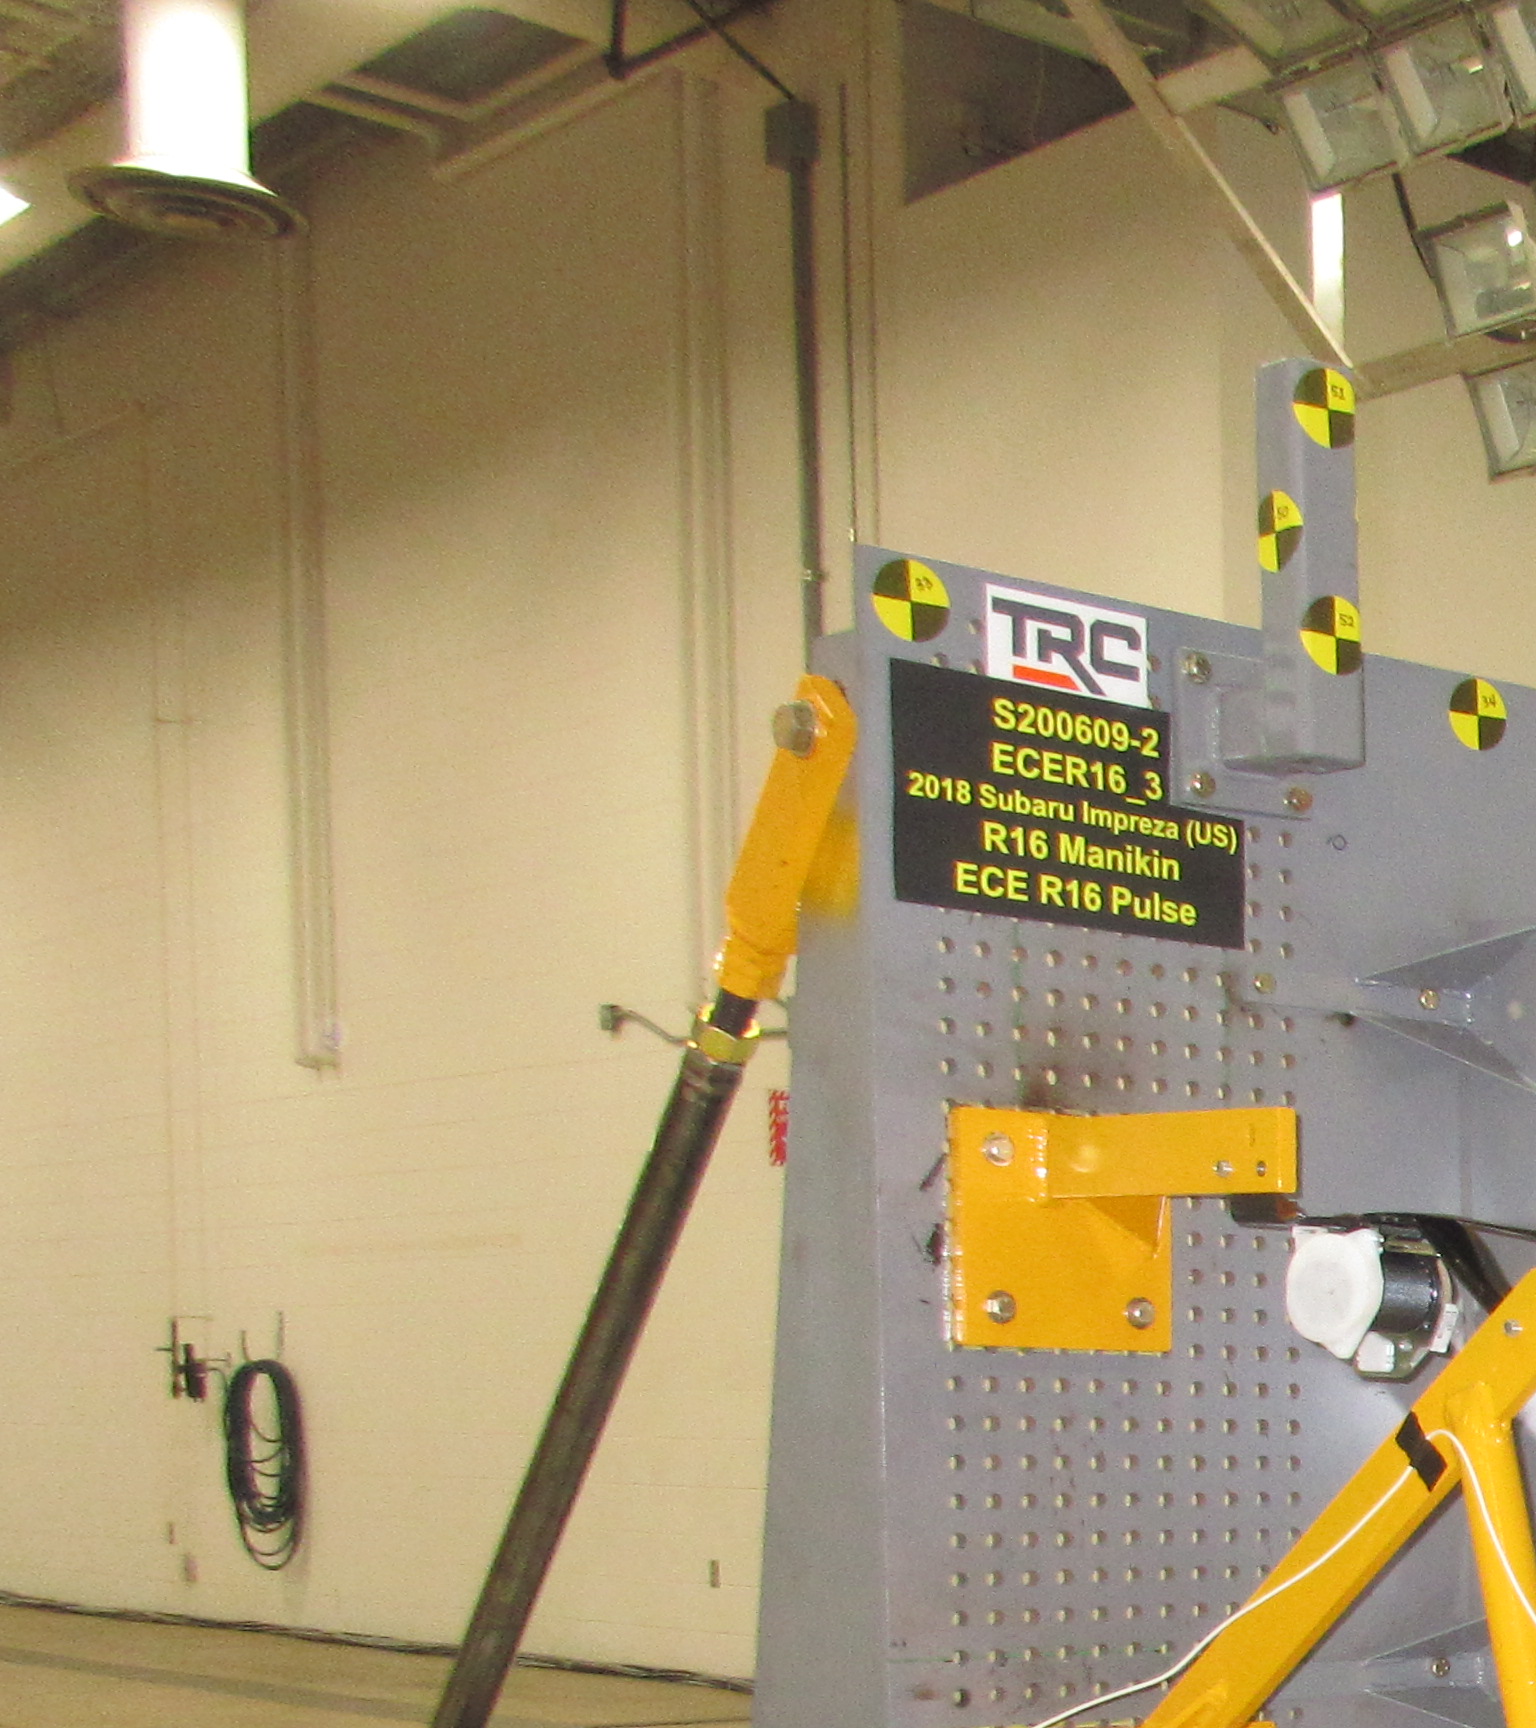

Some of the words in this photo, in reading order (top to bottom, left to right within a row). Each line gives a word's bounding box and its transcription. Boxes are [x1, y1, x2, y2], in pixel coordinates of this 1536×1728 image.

[991, 596, 1141, 697] TRC
[993, 698, 1160, 759] S200609-2
[990, 742, 1163, 806] ECER16_3
[907, 772, 973, 805] 2018
[978, 783, 1075, 823] Subaru
[1082, 801, 1180, 842] Impreza
[1186, 819, 1239, 855] (US)
[982, 821, 1049, 861] R16
[1058, 832, 1181, 881] Manikin
[954, 861, 1030, 903] ECE
[1039, 873, 1102, 913] R16
[1110, 885, 1198, 928] Pulse
